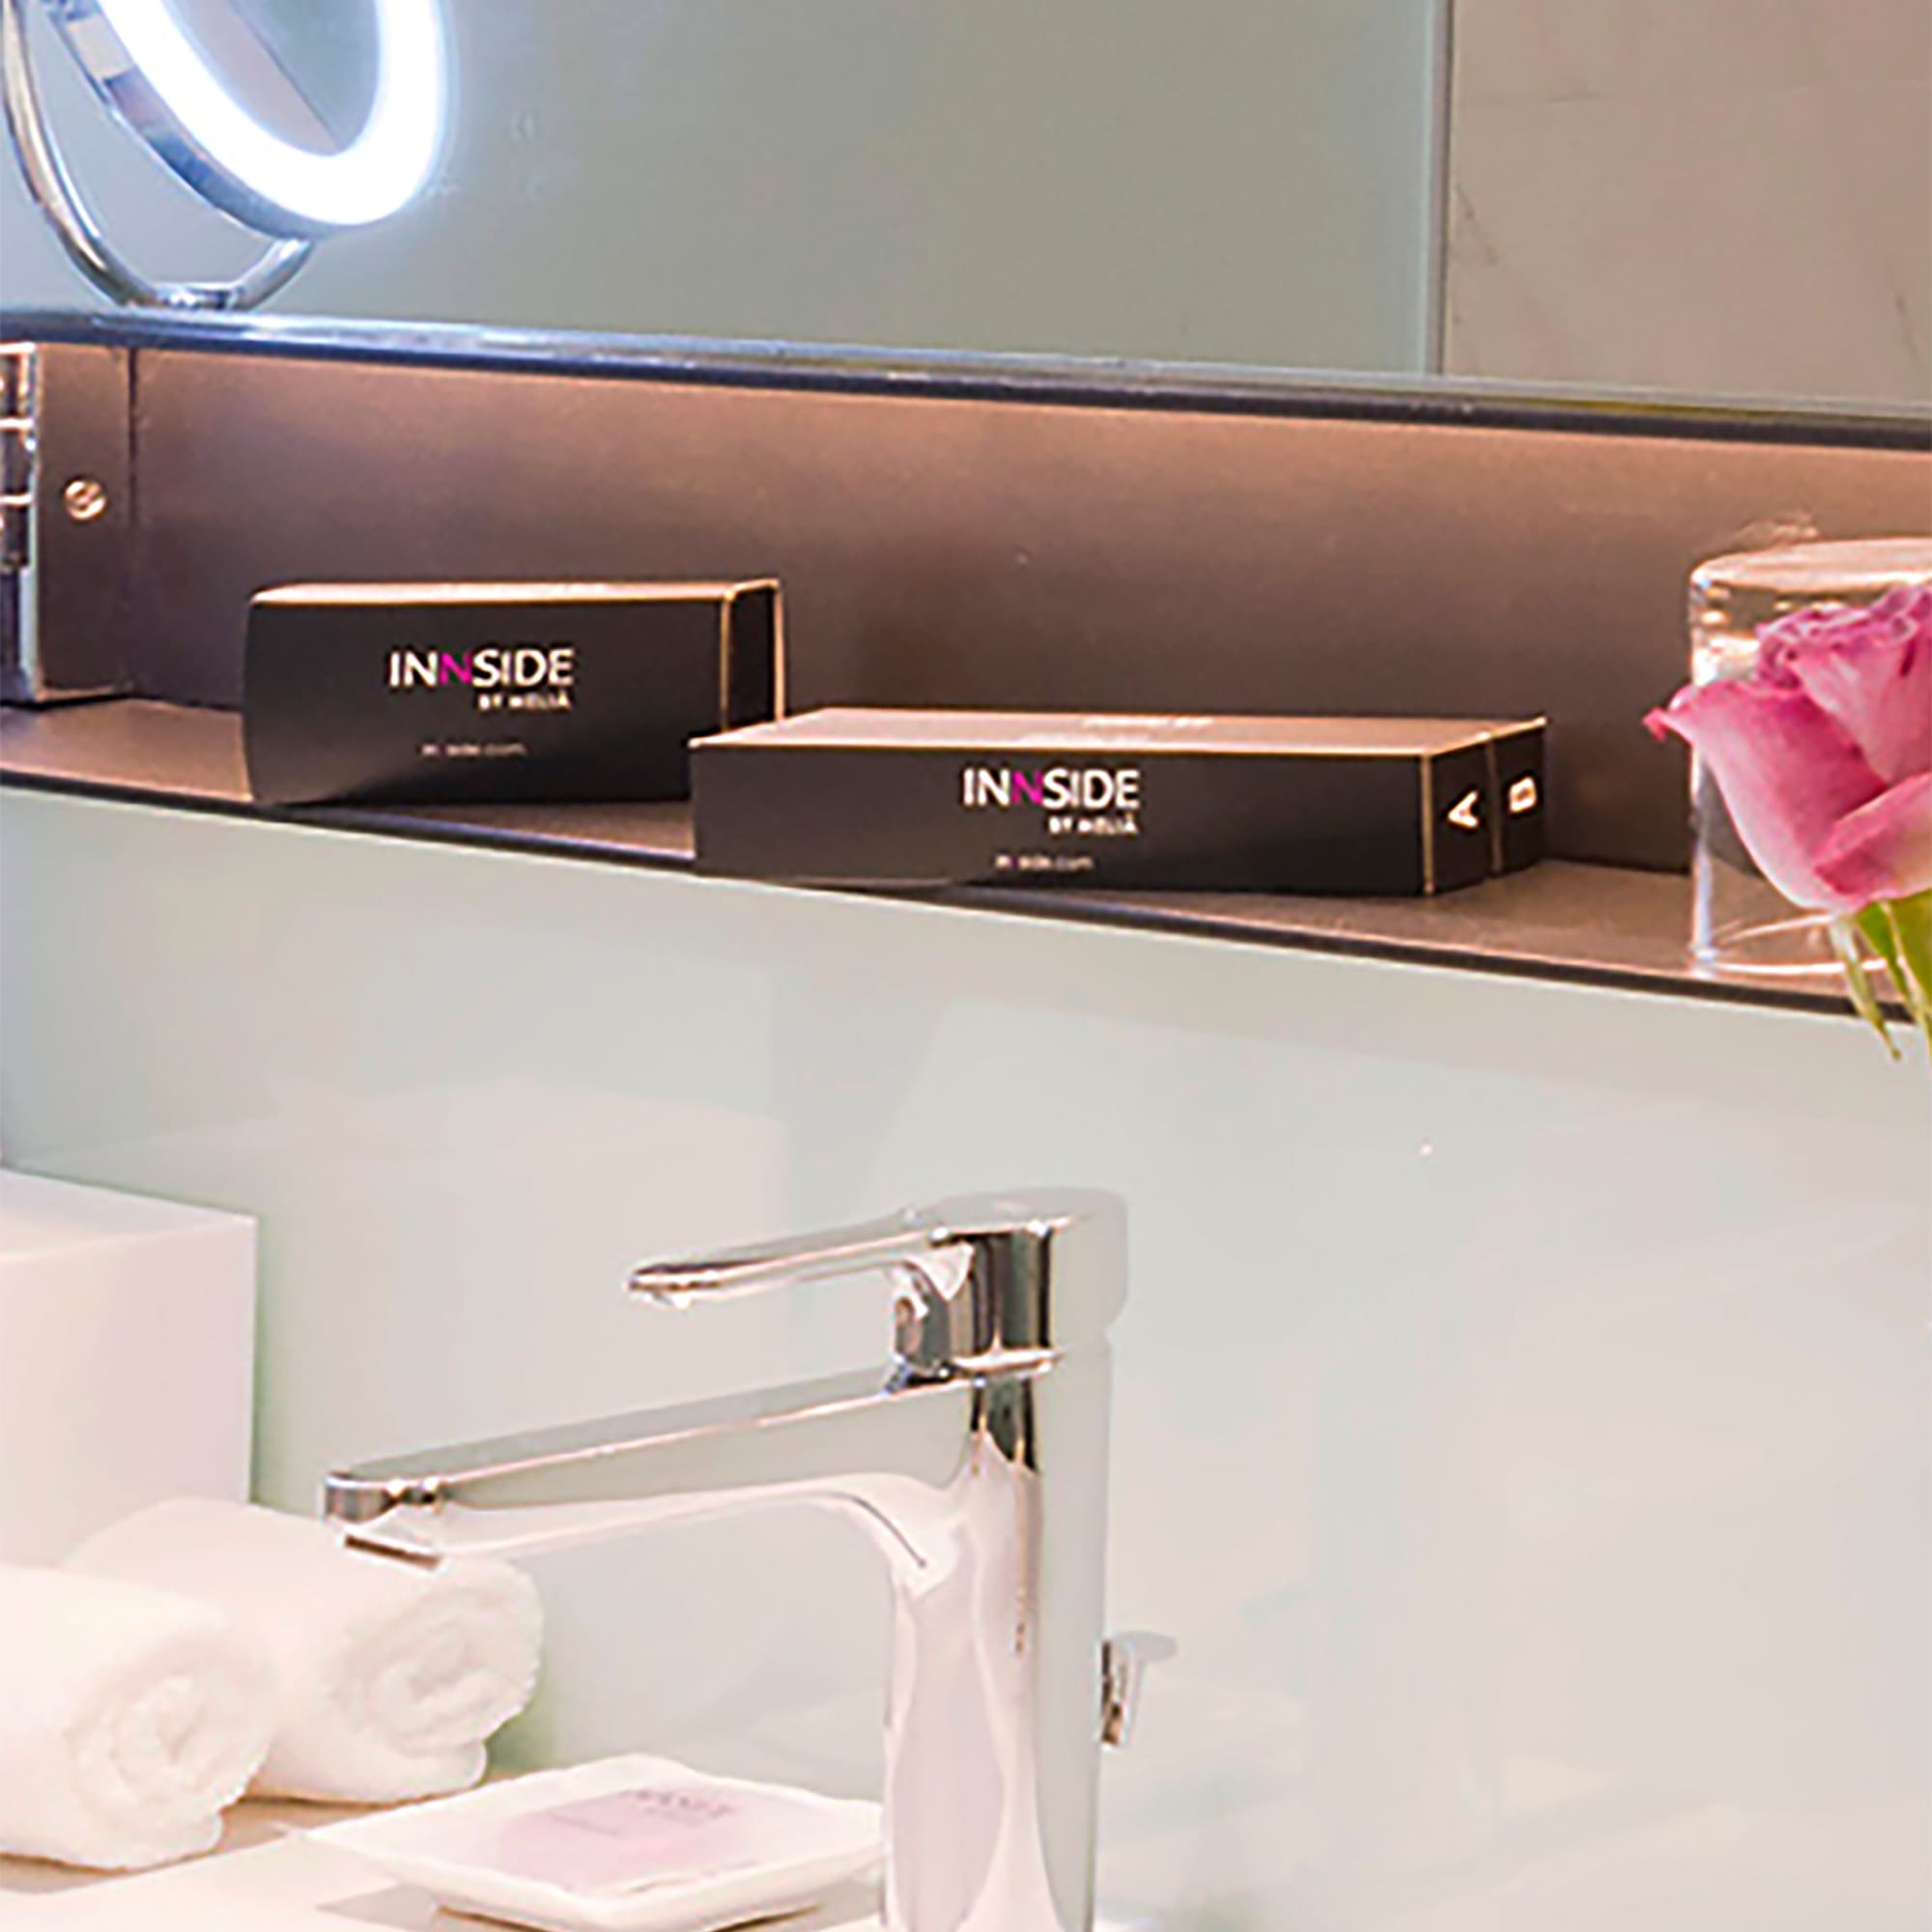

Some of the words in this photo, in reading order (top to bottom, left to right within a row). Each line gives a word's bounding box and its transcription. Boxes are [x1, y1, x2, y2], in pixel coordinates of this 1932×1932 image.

[389, 649, 574, 687] INNSIDE
[962, 767, 1140, 809] INNSIDE
[1447, 790, 1479, 828] A
